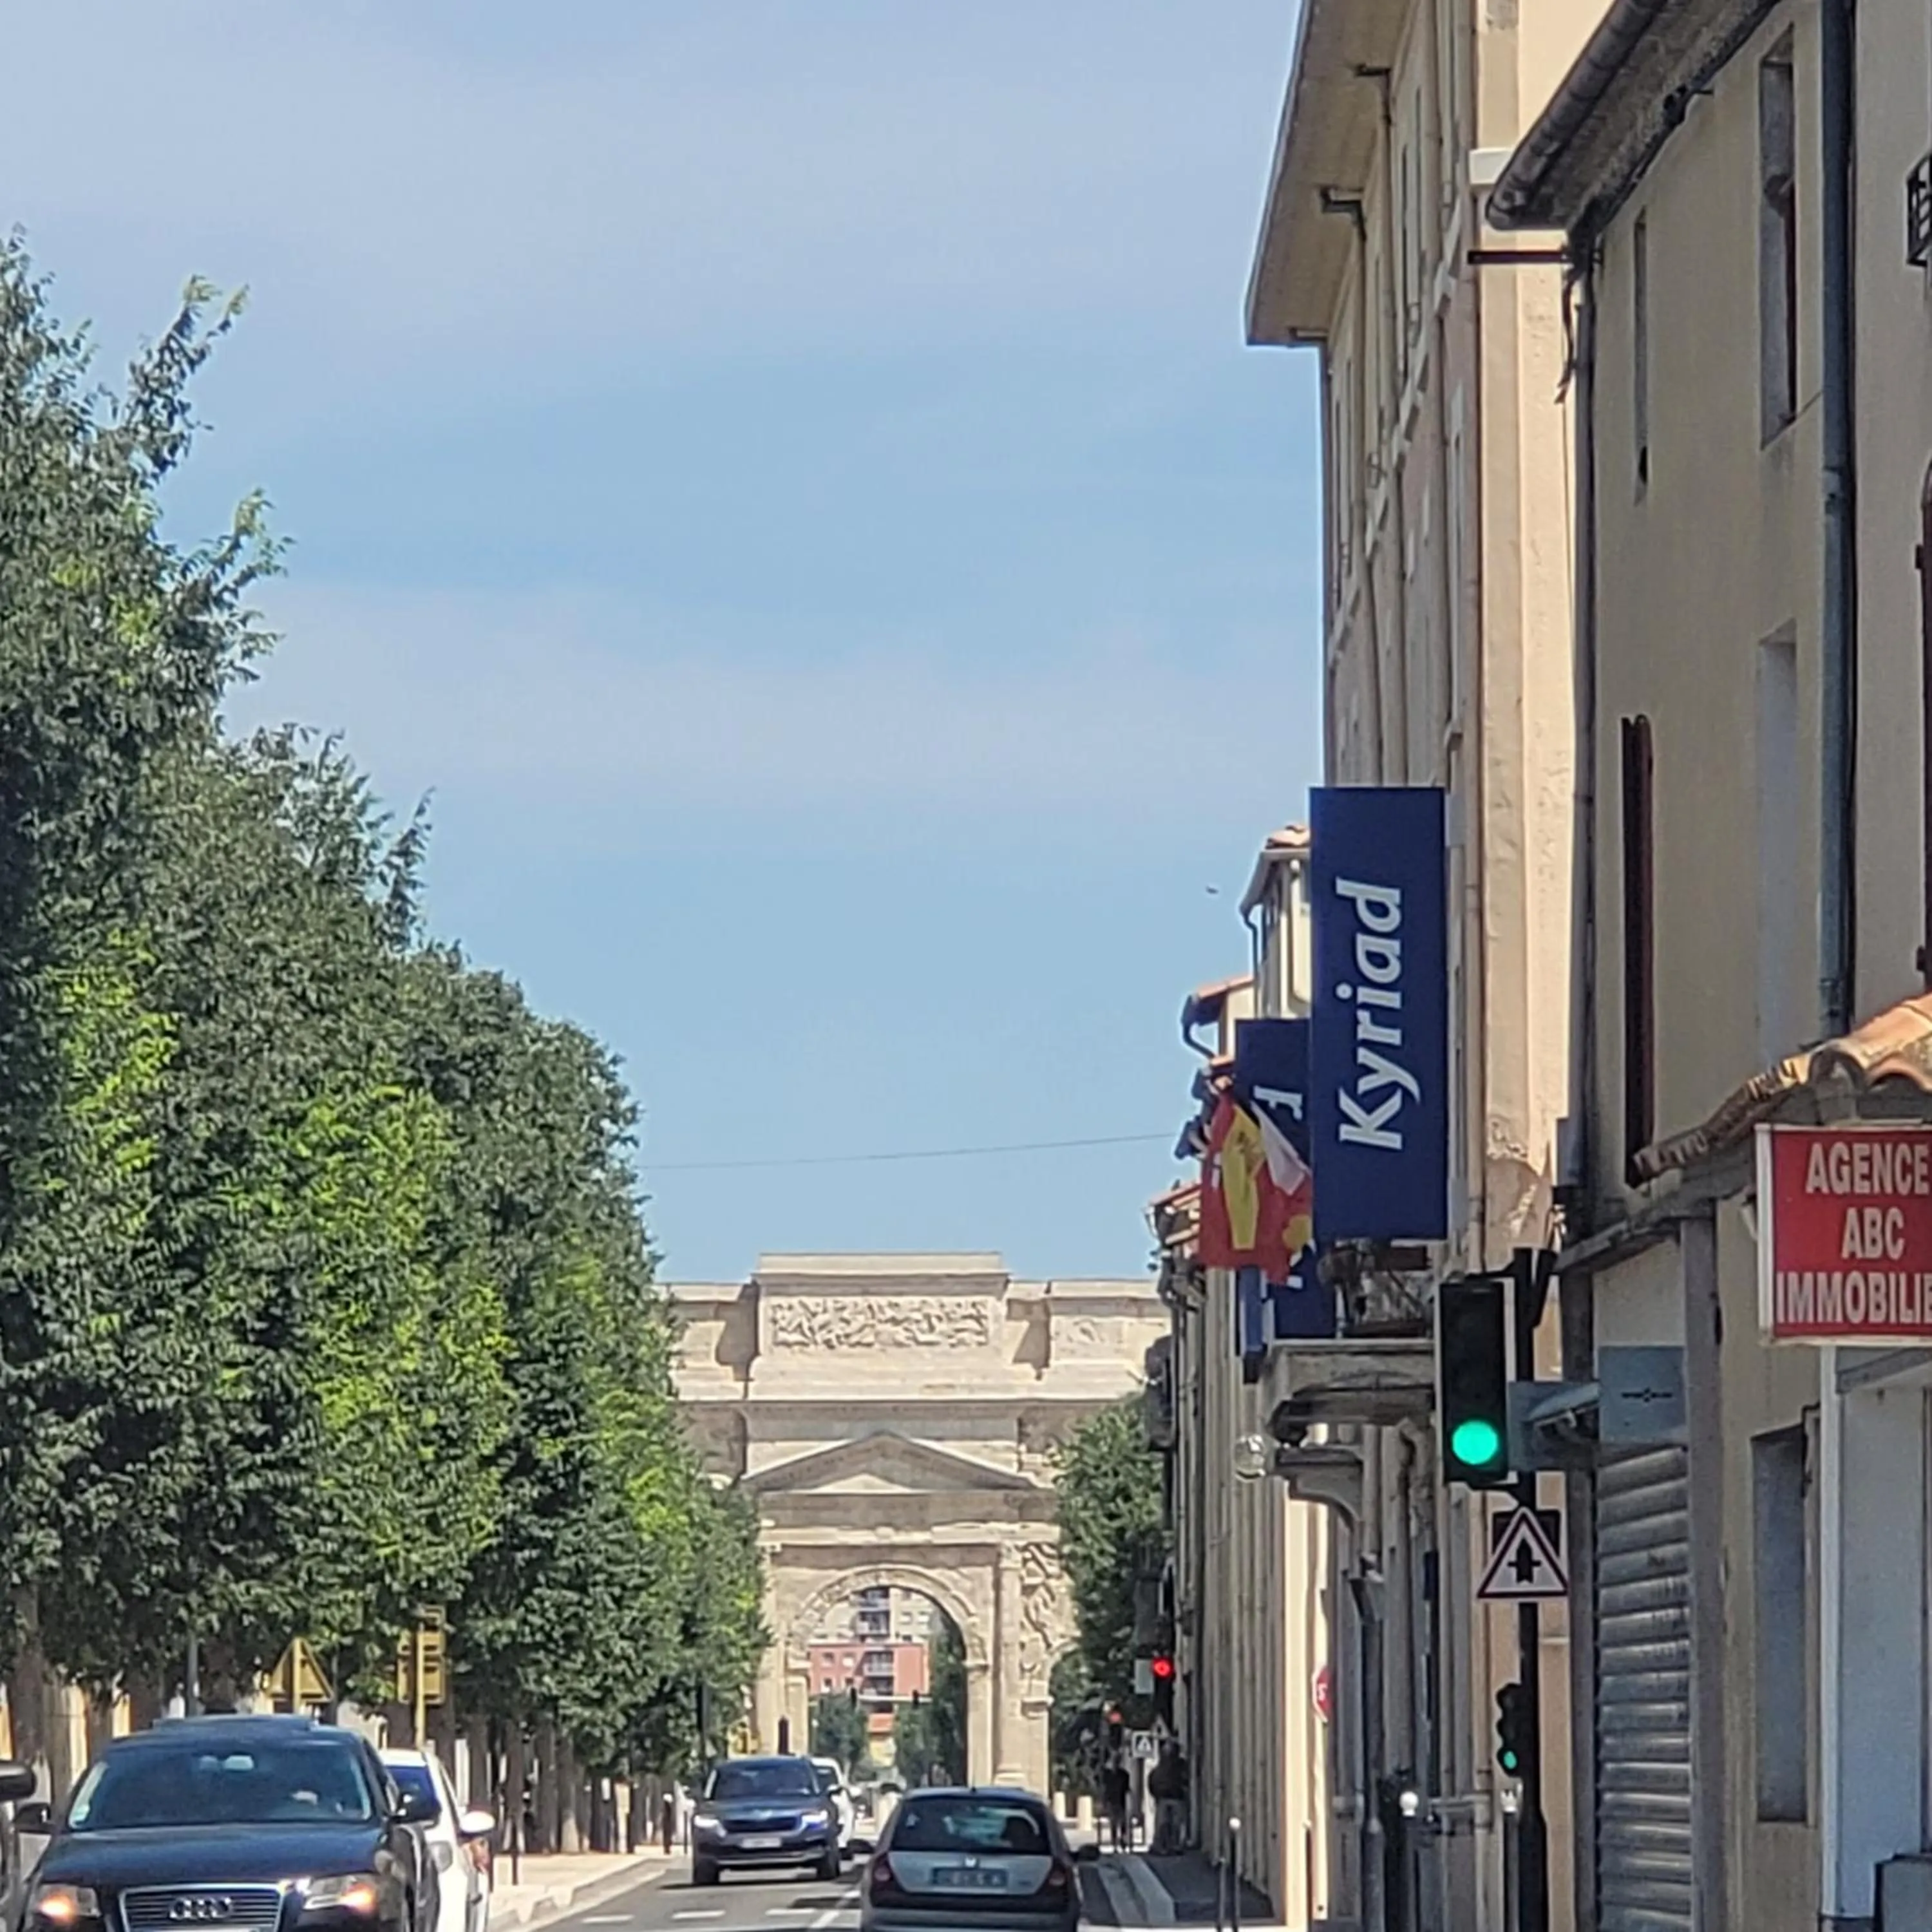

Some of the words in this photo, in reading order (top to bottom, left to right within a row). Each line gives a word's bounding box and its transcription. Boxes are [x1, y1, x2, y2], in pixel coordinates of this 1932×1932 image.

[1335, 876, 1421, 1150] Kyriad
[1805, 1141, 1930, 1196] AGENCE
[1841, 1206, 1906, 1260] ABC
